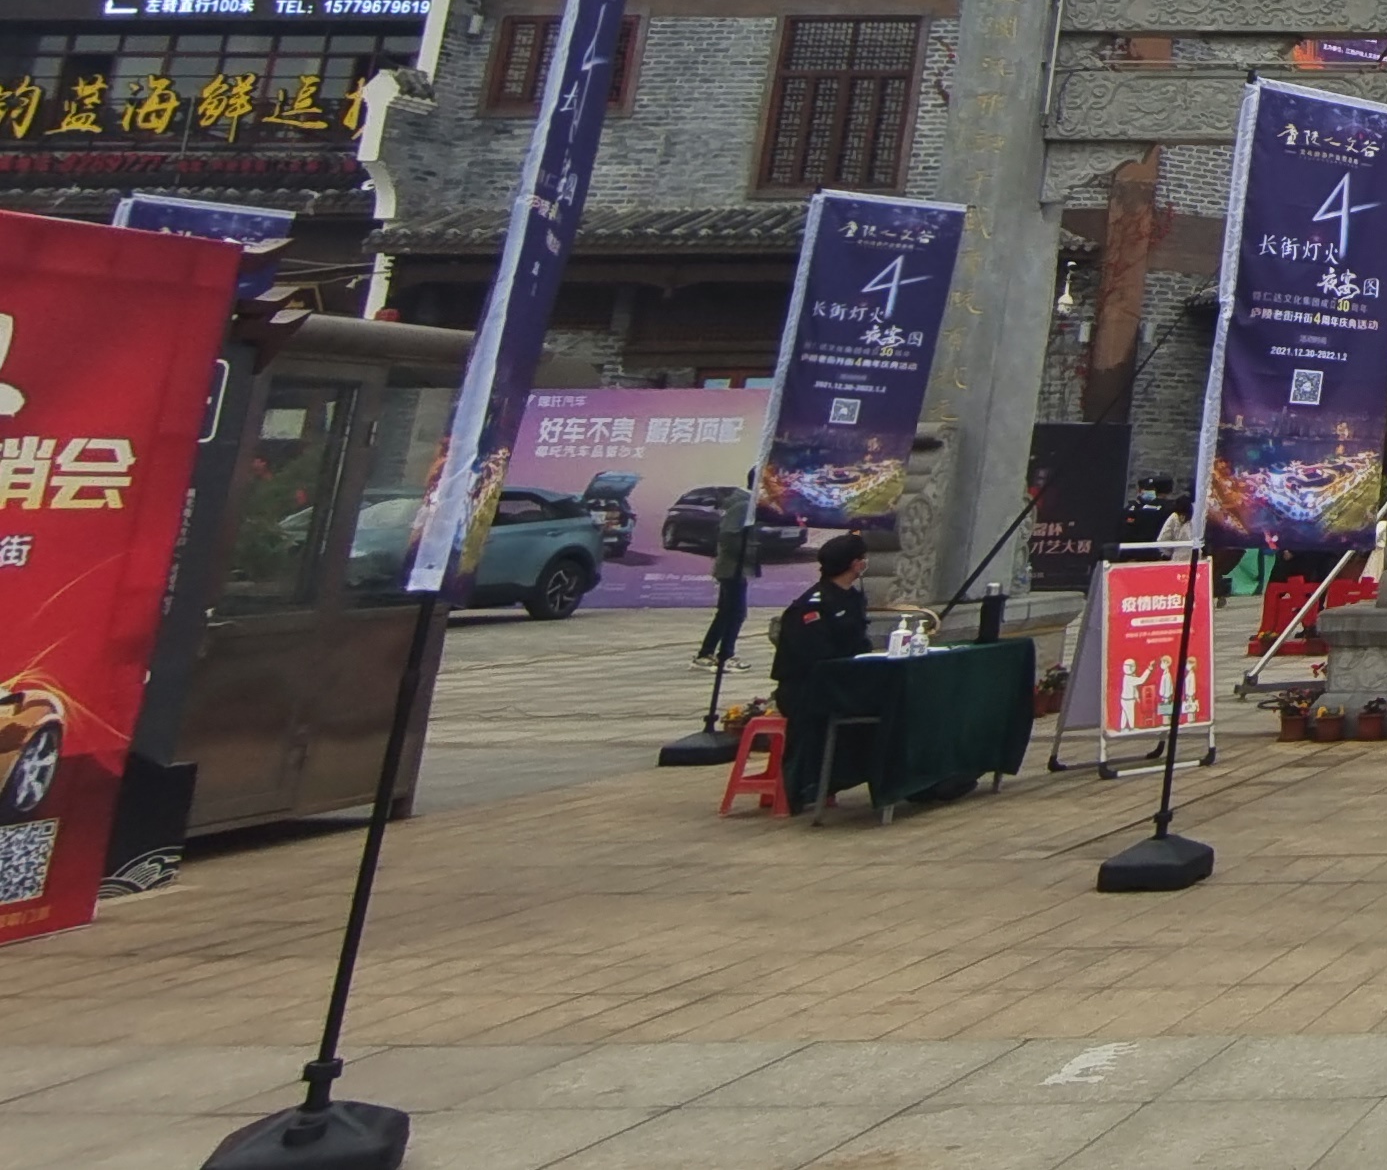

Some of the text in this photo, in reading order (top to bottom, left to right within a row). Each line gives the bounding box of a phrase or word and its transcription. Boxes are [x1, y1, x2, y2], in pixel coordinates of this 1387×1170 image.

[324, 0, 431, 15] 15779679619
[1312, 172, 1383, 259] 4
[1259, 234, 1339, 265] 长街灯火
[861, 255, 934, 319] 4
[1316, 267, 1380, 301] 夜宴图
[812, 300, 886, 323] 长街灯火
[1249, 307, 1379, 330] 庐陵老街开街4周年庆典活动
[860, 325, 924, 347] 夜宴图
[538, 417, 744, 443] 好车不贵 服务顶配
